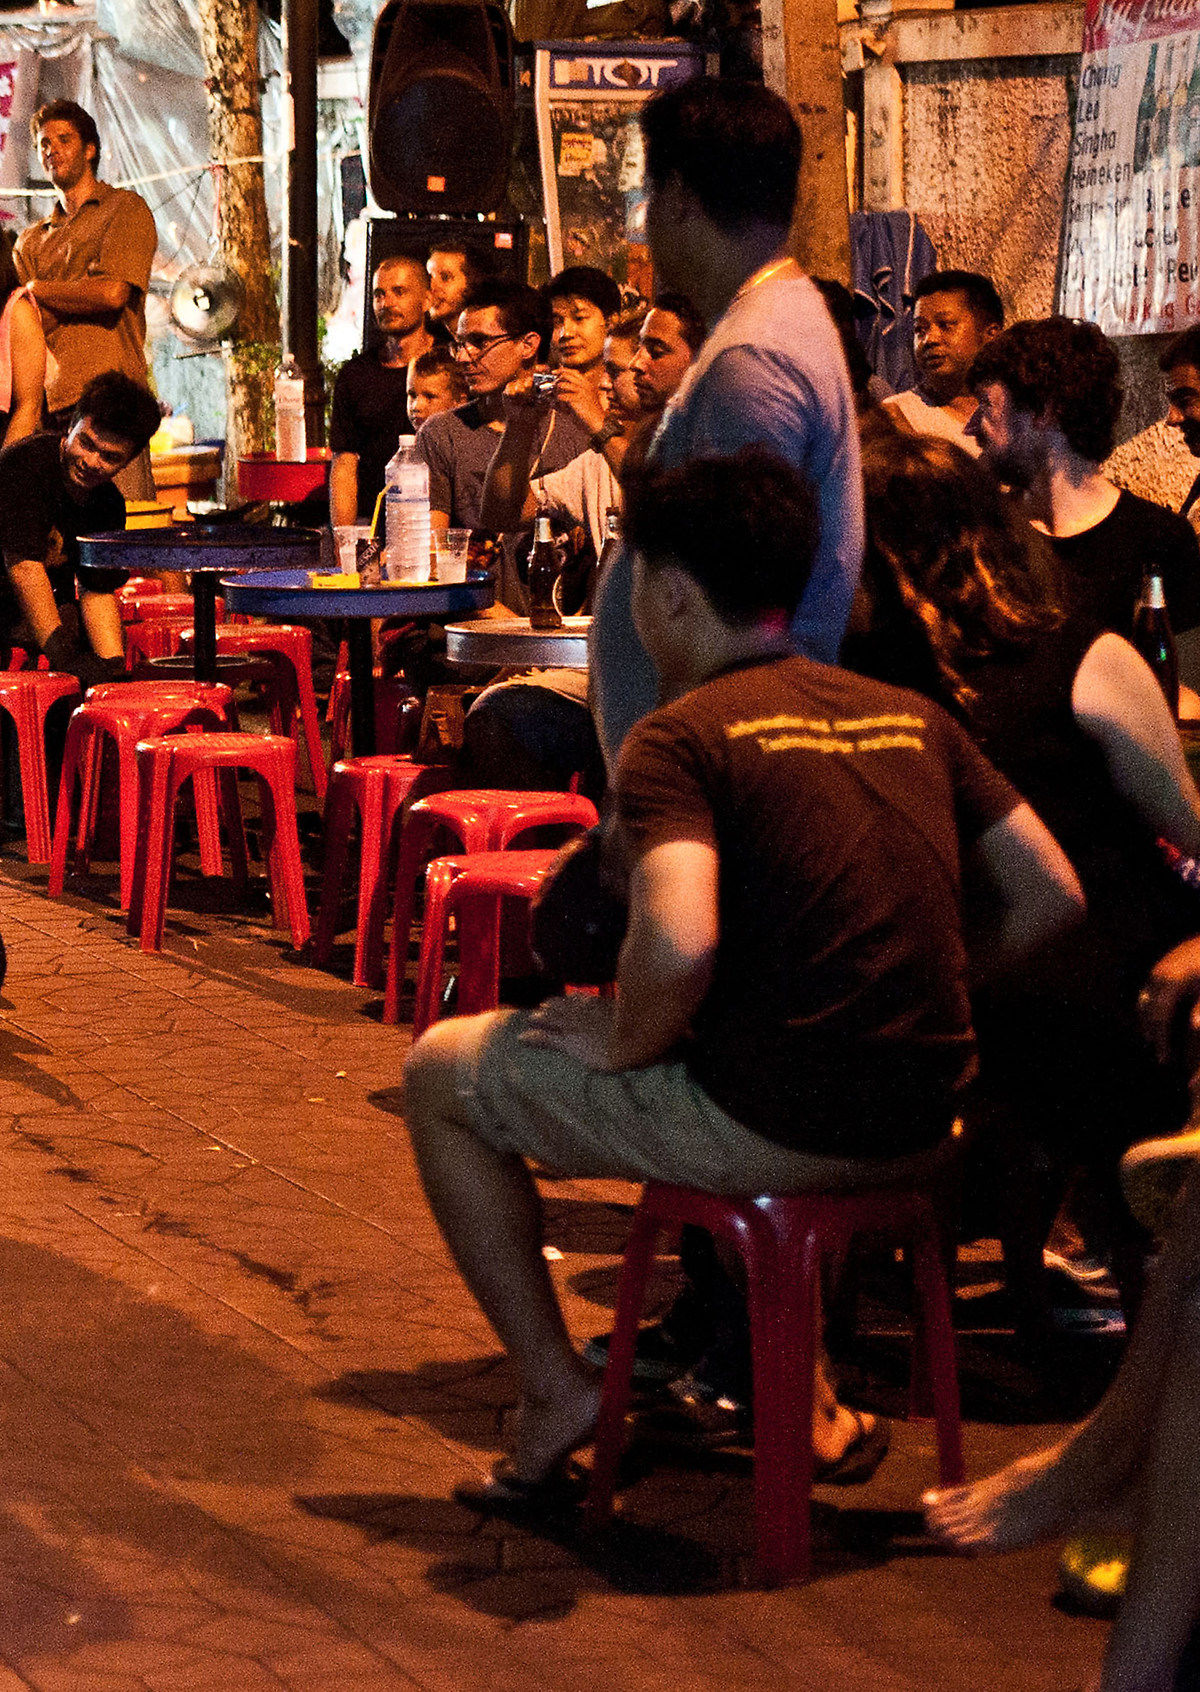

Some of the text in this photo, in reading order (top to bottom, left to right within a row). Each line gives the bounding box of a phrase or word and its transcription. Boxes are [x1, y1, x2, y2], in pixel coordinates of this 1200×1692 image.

[575, 57, 678, 87] TOT
[1076, 99, 1100, 124] Leo
[1072, 128, 1118, 159] Singha
